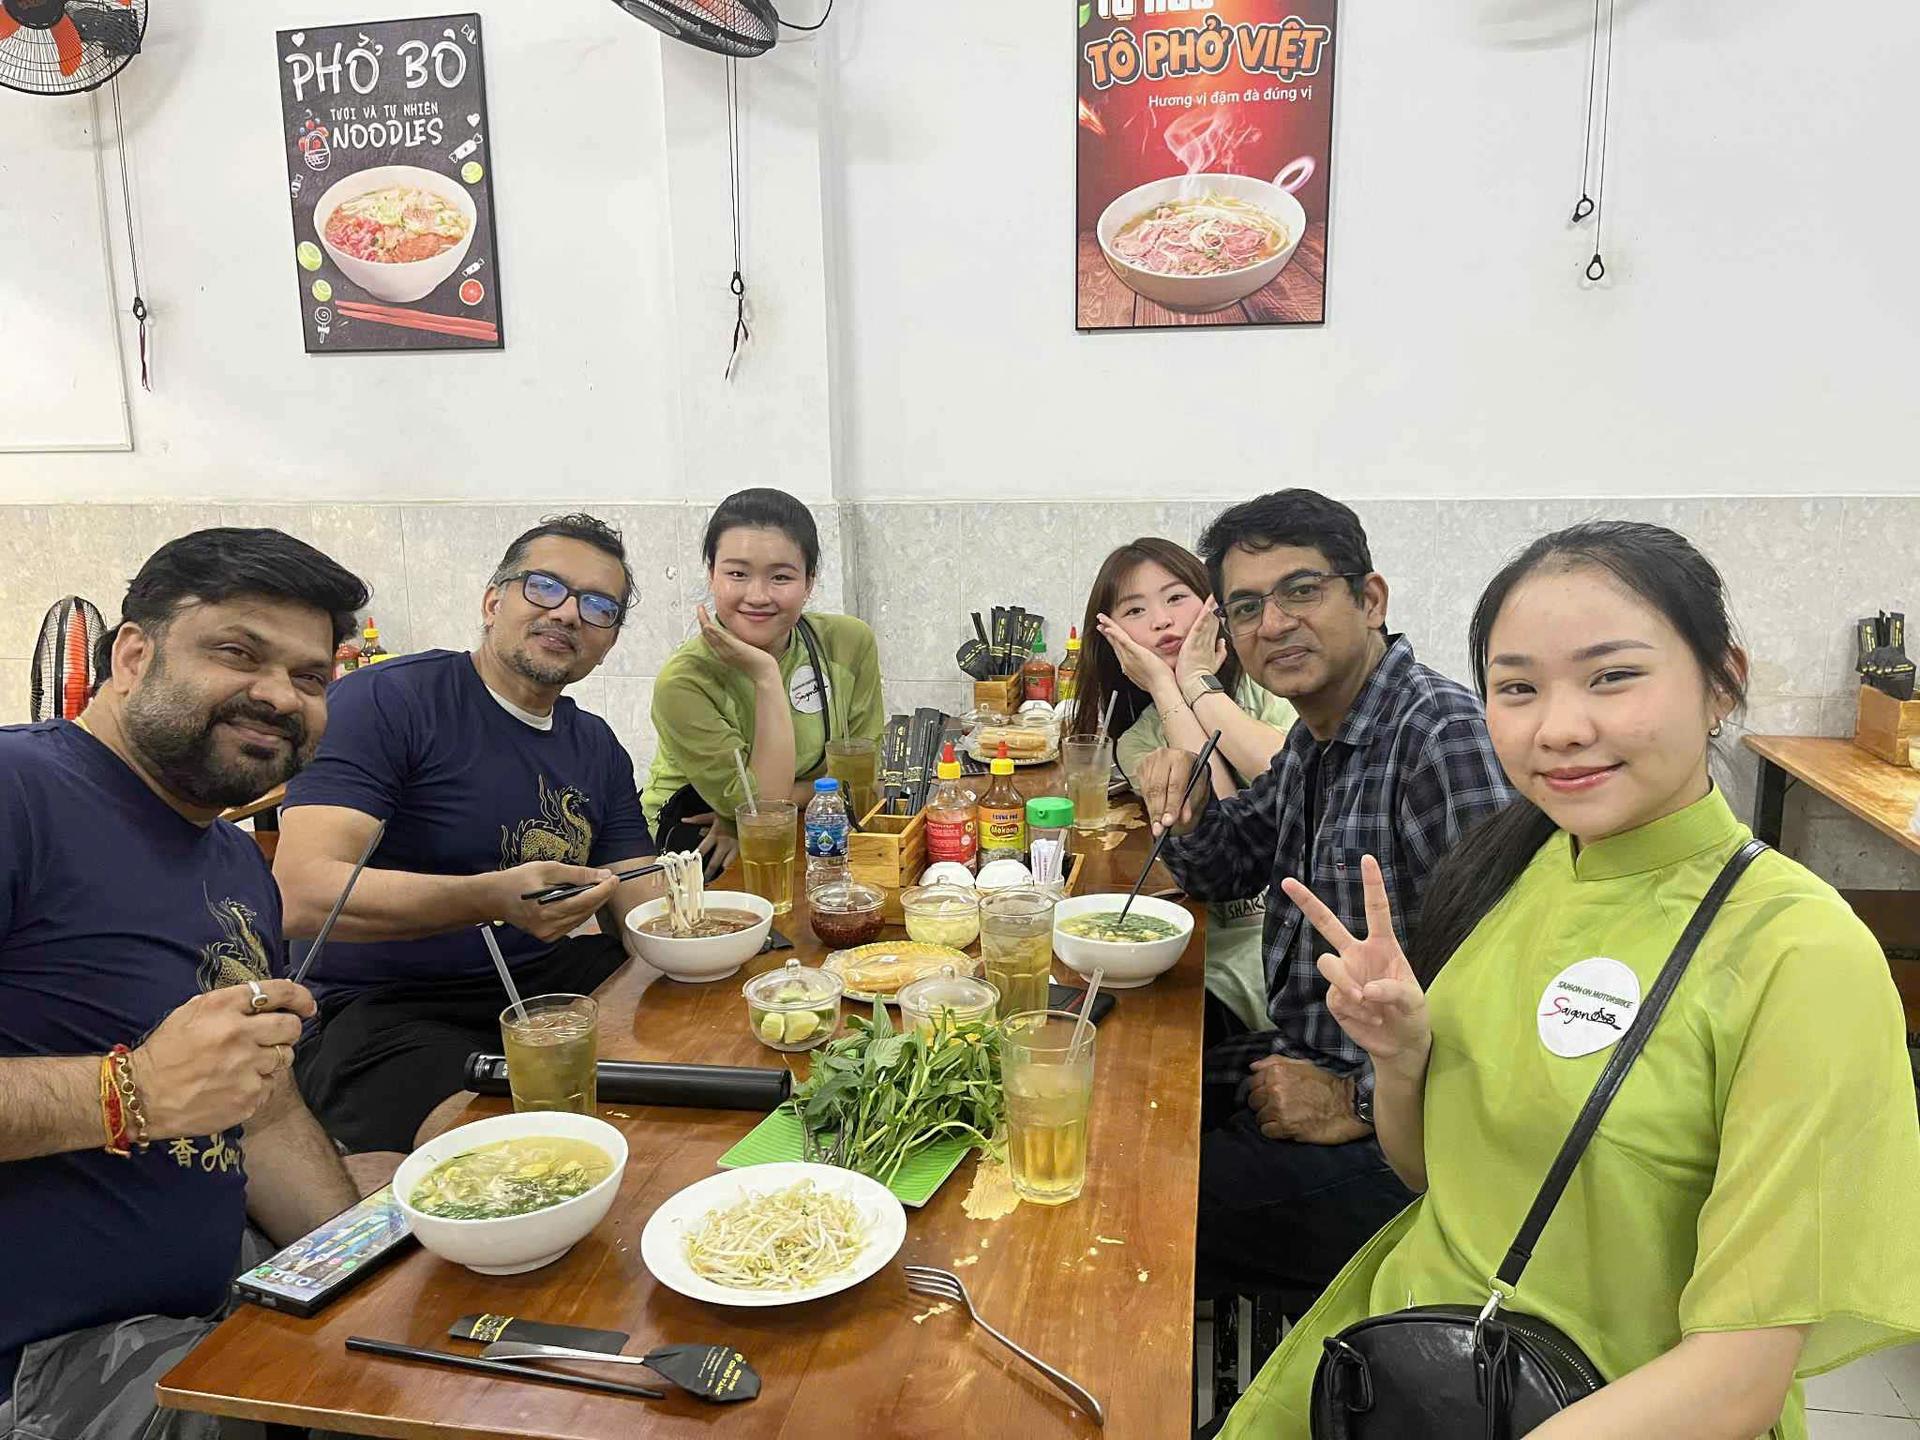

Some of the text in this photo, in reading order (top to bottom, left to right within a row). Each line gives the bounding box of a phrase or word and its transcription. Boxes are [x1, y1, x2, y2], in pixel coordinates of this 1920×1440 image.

[285, 33, 383, 101] PHỞ
[1087, 17, 1328, 87] TÔ PHỞ VIỆT
[1263, 87, 1296, 101] đúng
[1300, 85, 1312, 100] vị
[333, 117, 444, 149] NOODLES
[1582, 988, 1592, 996] ON
